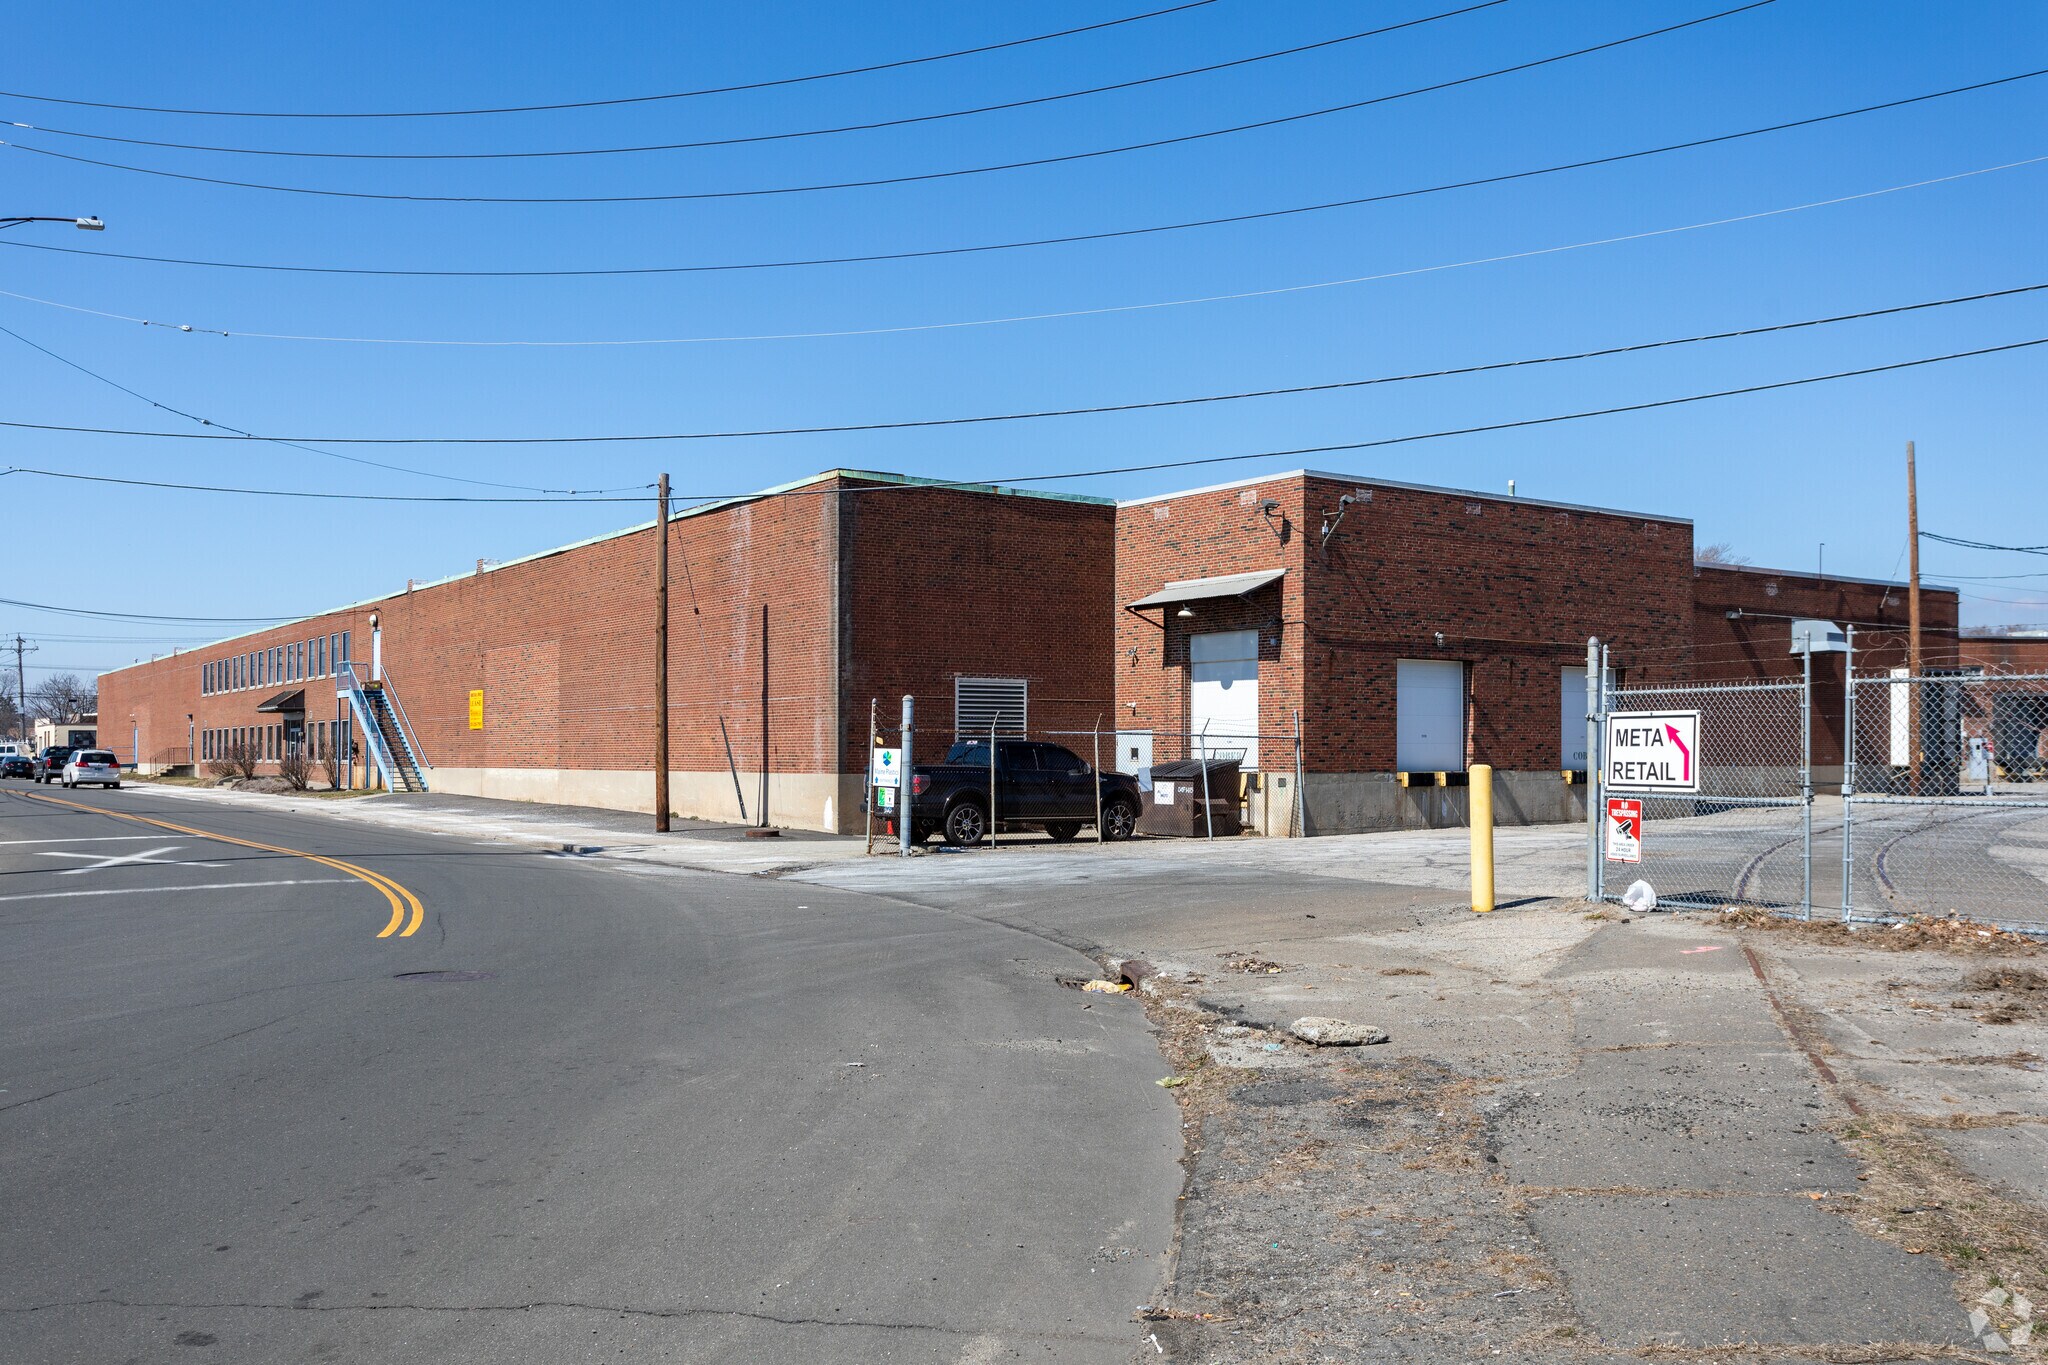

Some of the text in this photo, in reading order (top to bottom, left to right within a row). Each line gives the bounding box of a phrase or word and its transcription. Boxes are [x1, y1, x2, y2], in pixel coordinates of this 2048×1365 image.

[1615, 728, 1664, 747] META
[1613, 762, 1676, 781] RETAIL
[1621, 801, 1629, 809] NO
[1611, 809, 1638, 818] TRESPASSING
